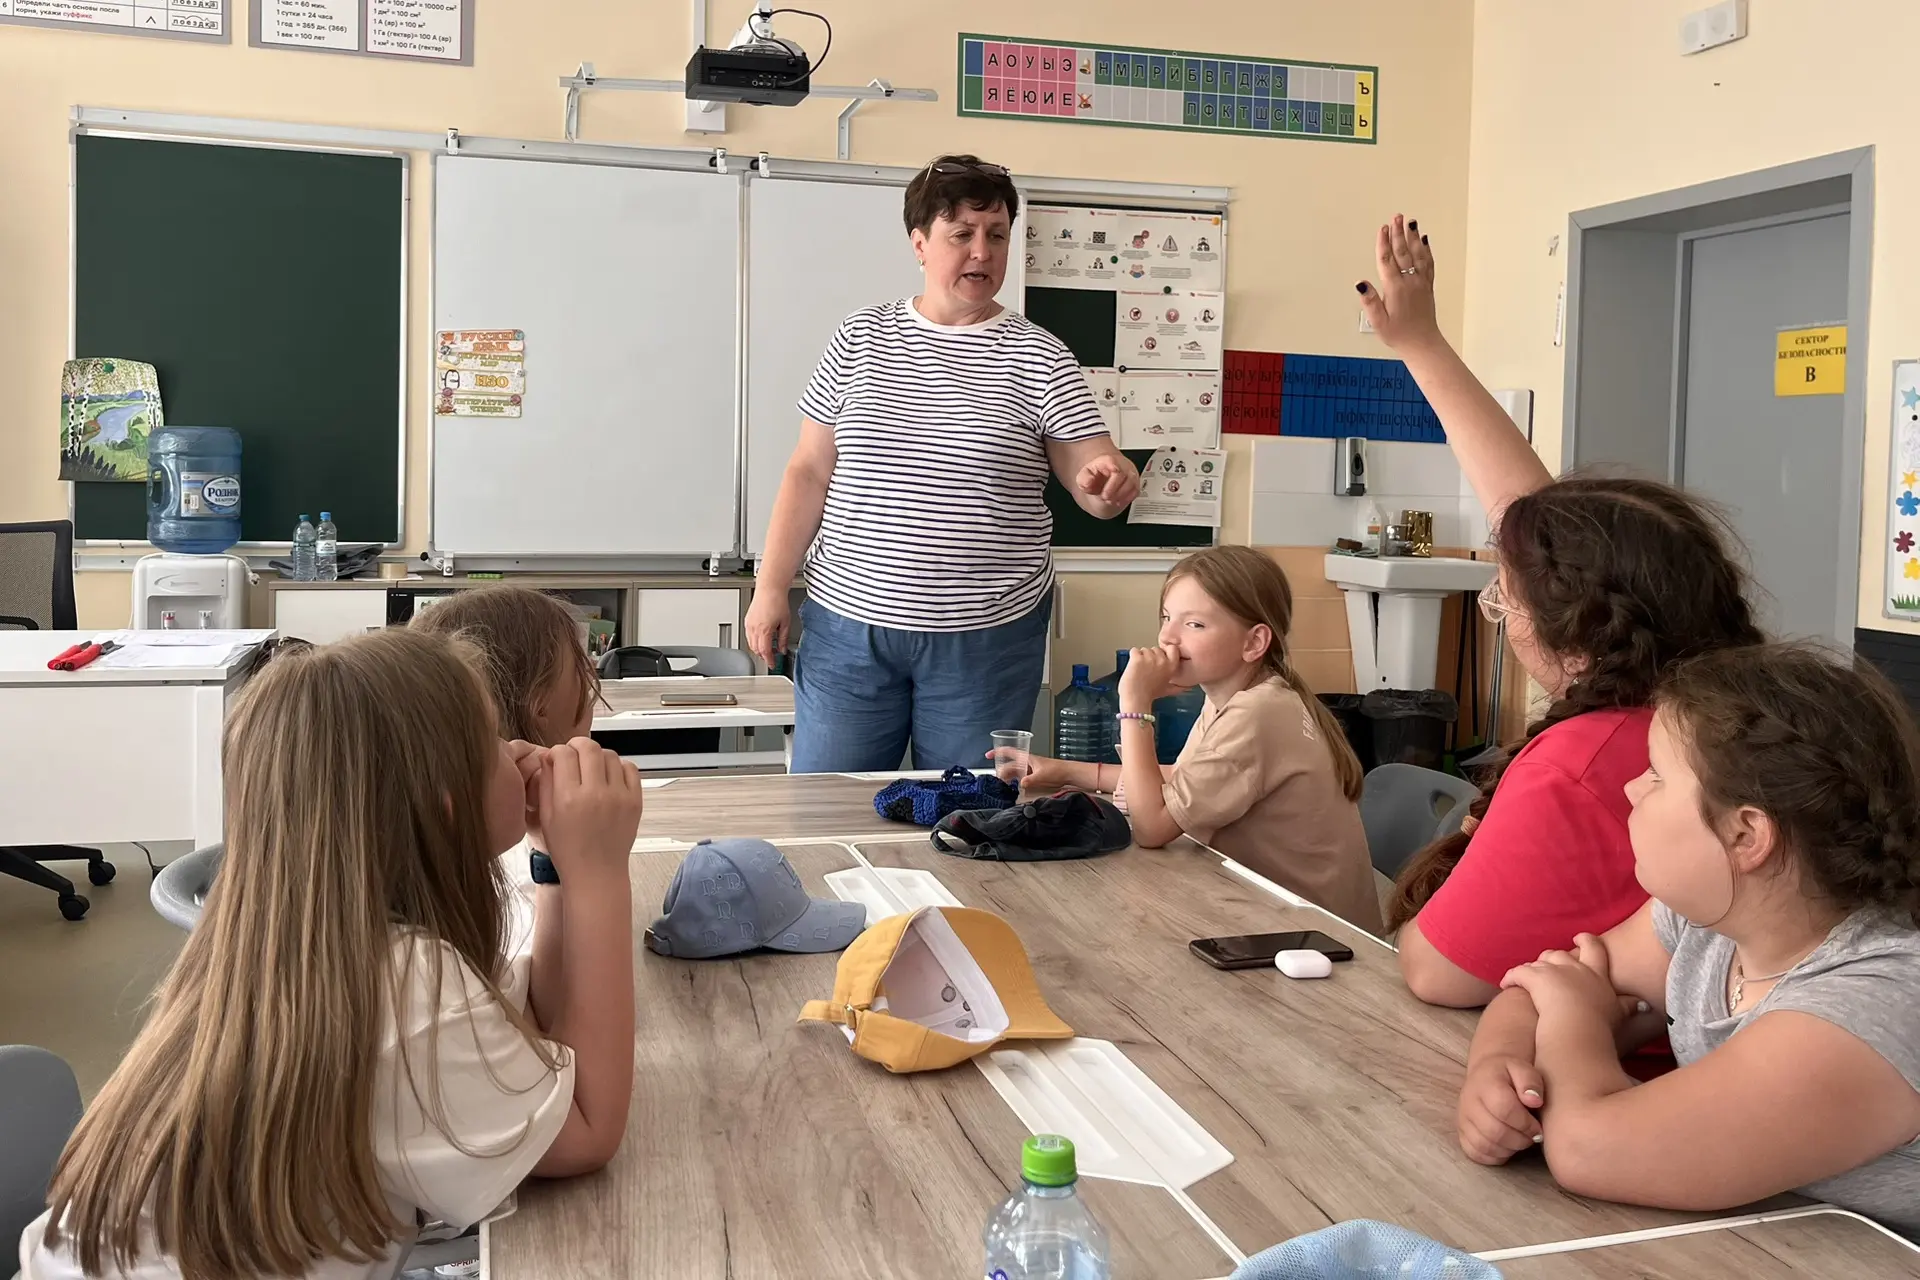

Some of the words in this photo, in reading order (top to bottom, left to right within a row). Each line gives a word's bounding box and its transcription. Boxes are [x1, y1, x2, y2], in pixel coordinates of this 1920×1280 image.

[72, 4, 98, 12] основы
[300, 0, 310, 8] 60
[424, 3, 445, 11] 10000
[62, 11, 93, 19] суффикс
[302, 22, 315, 30] 365
[1795, 335, 1829, 345] СЕКТОР
[1778, 346, 1846, 360] БЕЗОПАСНОСТИ
